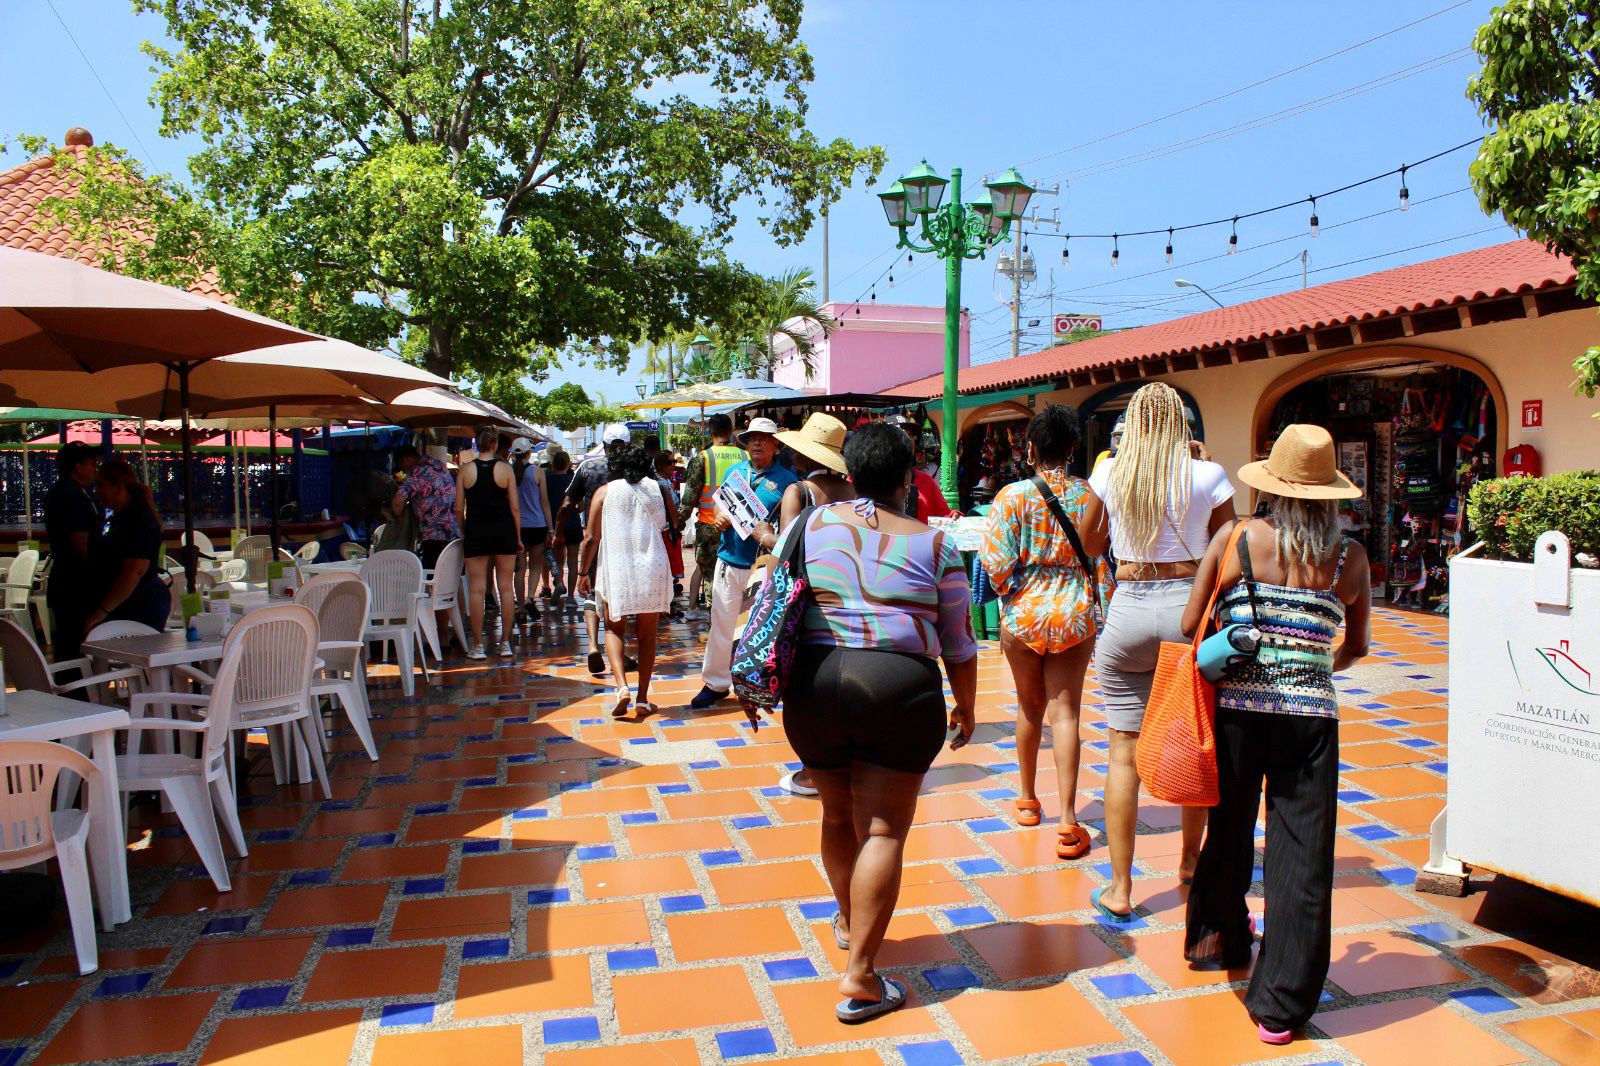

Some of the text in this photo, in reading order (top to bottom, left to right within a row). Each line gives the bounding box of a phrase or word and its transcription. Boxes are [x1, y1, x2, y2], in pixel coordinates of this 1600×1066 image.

[1058, 319, 1100, 333] OXXO
[714, 452, 742, 460] MARINA
[748, 492, 756, 502] FOR
[1516, 701, 1590, 725] MAZATLÁN
[1487, 718, 1556, 740] COORDINACIÓN
[1484, 728, 1521, 743] PUERTOS
[1531, 740, 1569, 755] MARINA
[1571, 747, 1600, 762] MERC
